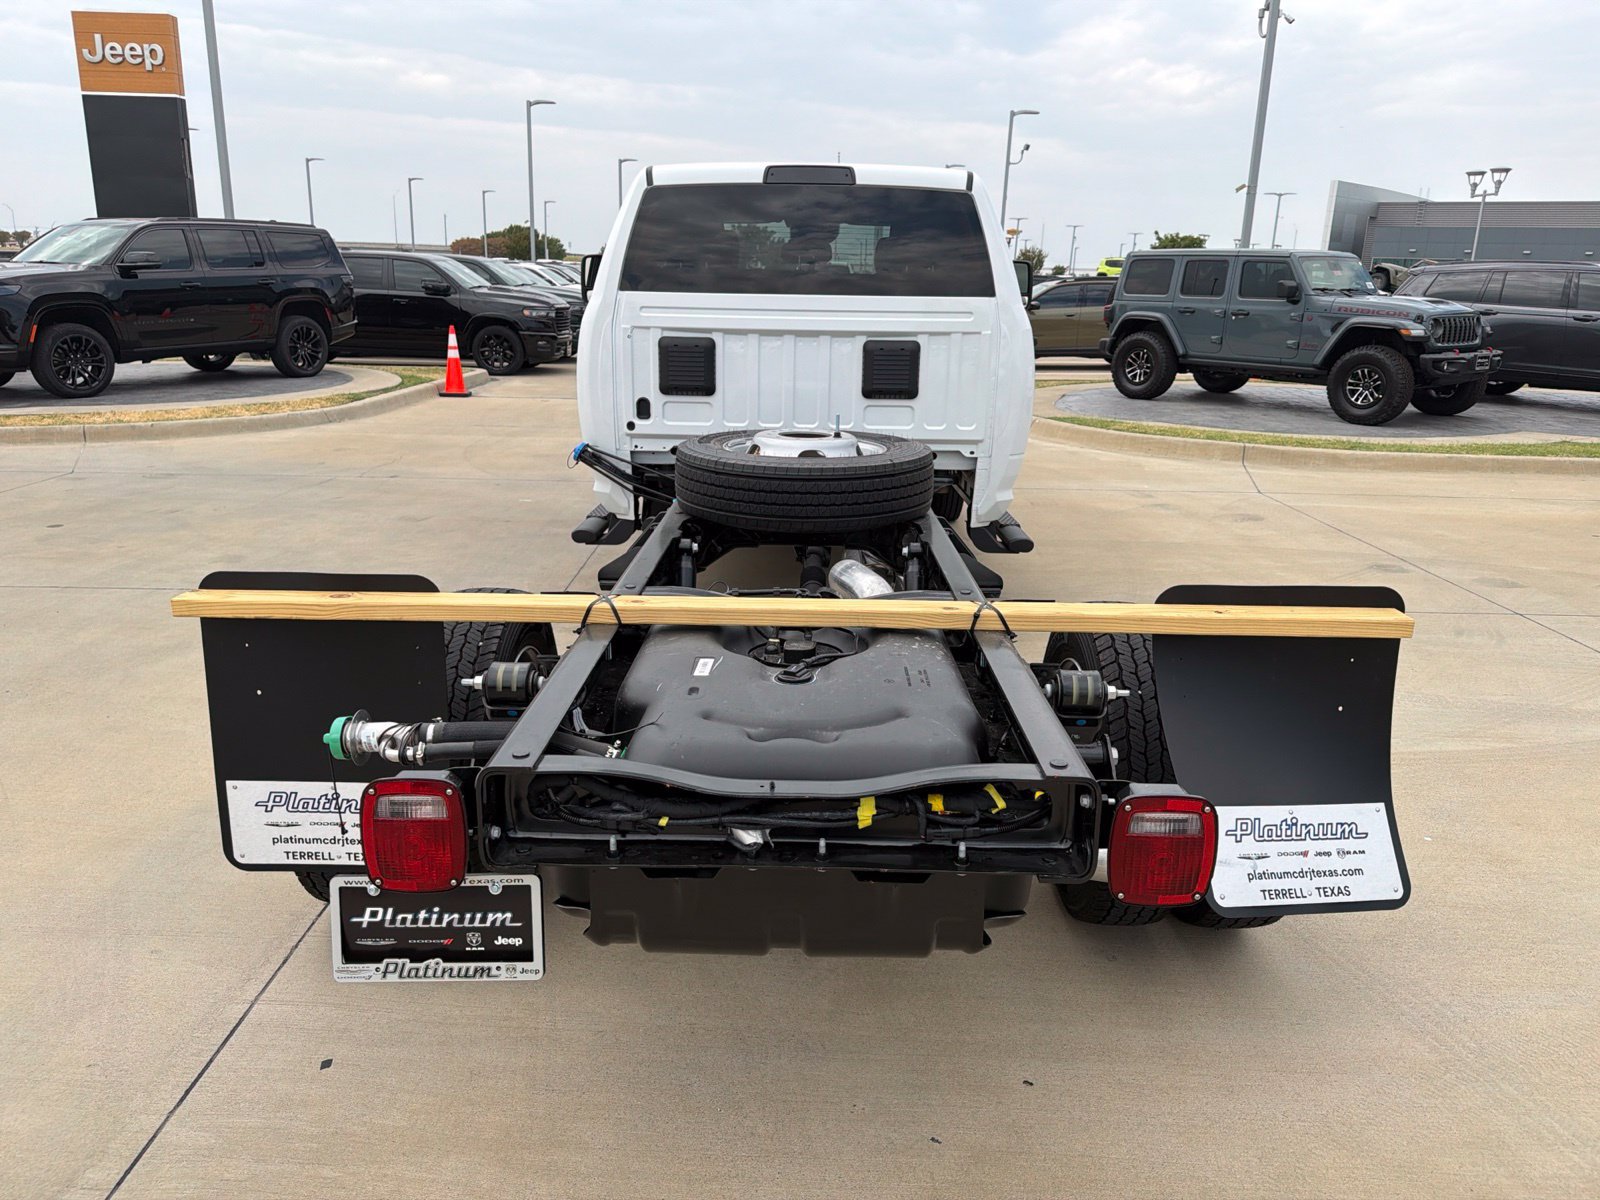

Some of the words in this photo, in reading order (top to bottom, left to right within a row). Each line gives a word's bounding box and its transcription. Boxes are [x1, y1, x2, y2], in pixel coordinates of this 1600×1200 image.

[82, 33, 164, 71] Jeep
[1337, 306, 1410, 318] RUBICON
[254, 791, 361, 814] Platin
[1225, 816, 1369, 843] Platinum
[272, 835, 362, 847] platinumcdrjtex
[283, 851, 335, 861] TERRELL
[1313, 850, 1333, 858] Jeep
[1247, 867, 1364, 882] platinumcdrjtexas.com
[1261, 888, 1307, 900] TERRELL
[1315, 885, 1351, 898] TEXAS
[350, 906, 523, 928] Platinum
[494, 935, 523, 947] Jeep
[381, 959, 500, 979] Platinum
[519, 967, 540, 976] Jeep
